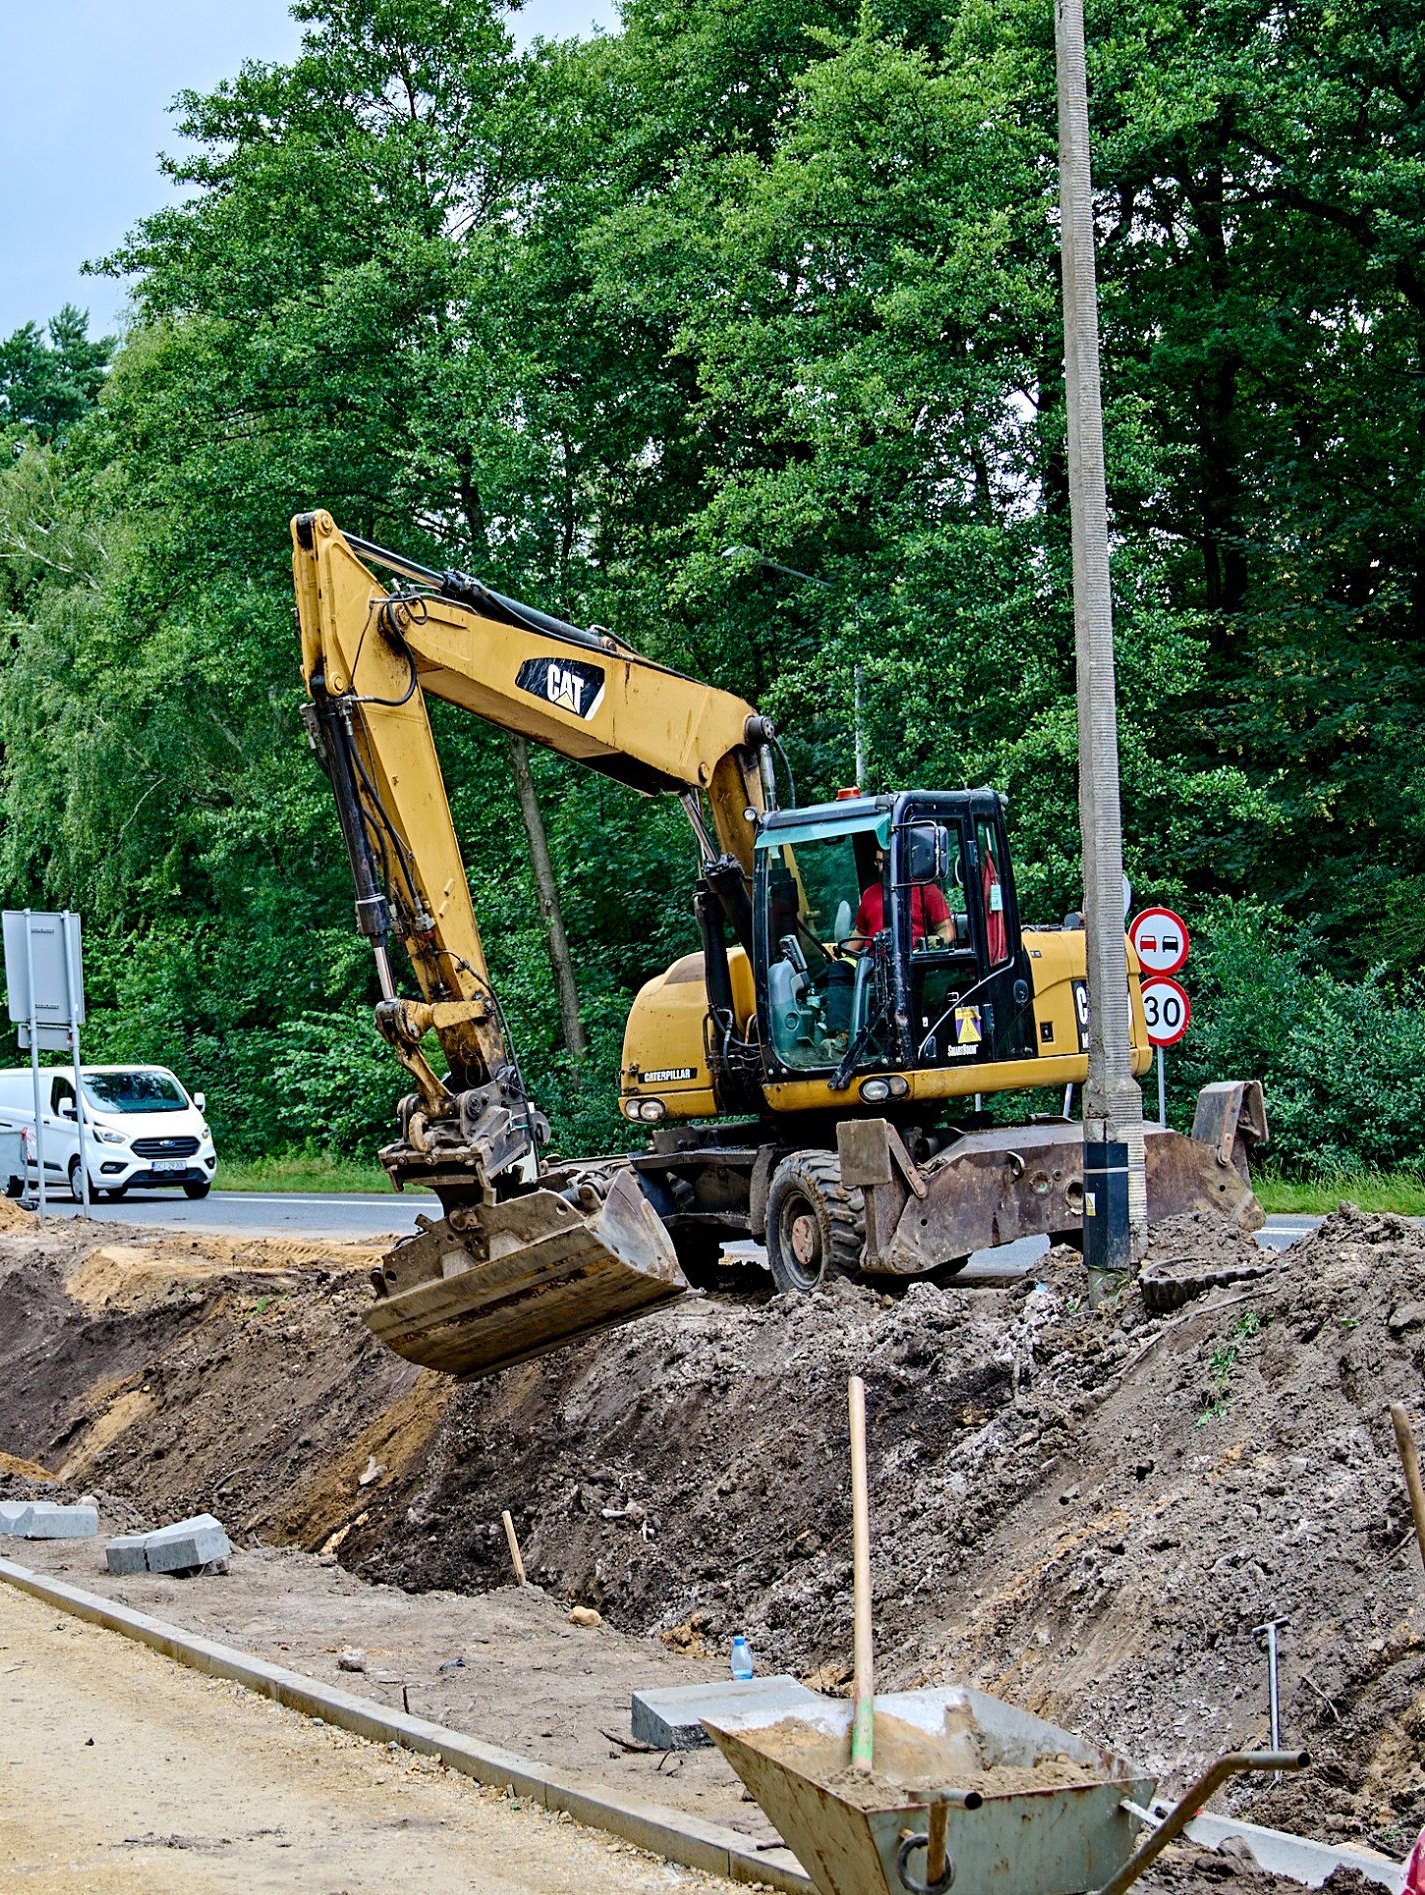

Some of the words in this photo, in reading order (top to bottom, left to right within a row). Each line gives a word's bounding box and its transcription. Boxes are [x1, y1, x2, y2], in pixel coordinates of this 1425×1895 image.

[547, 664, 585, 714] CAT
[1143, 996, 1180, 1027] 30
[644, 1069, 691, 1083] CATERPILLAR
